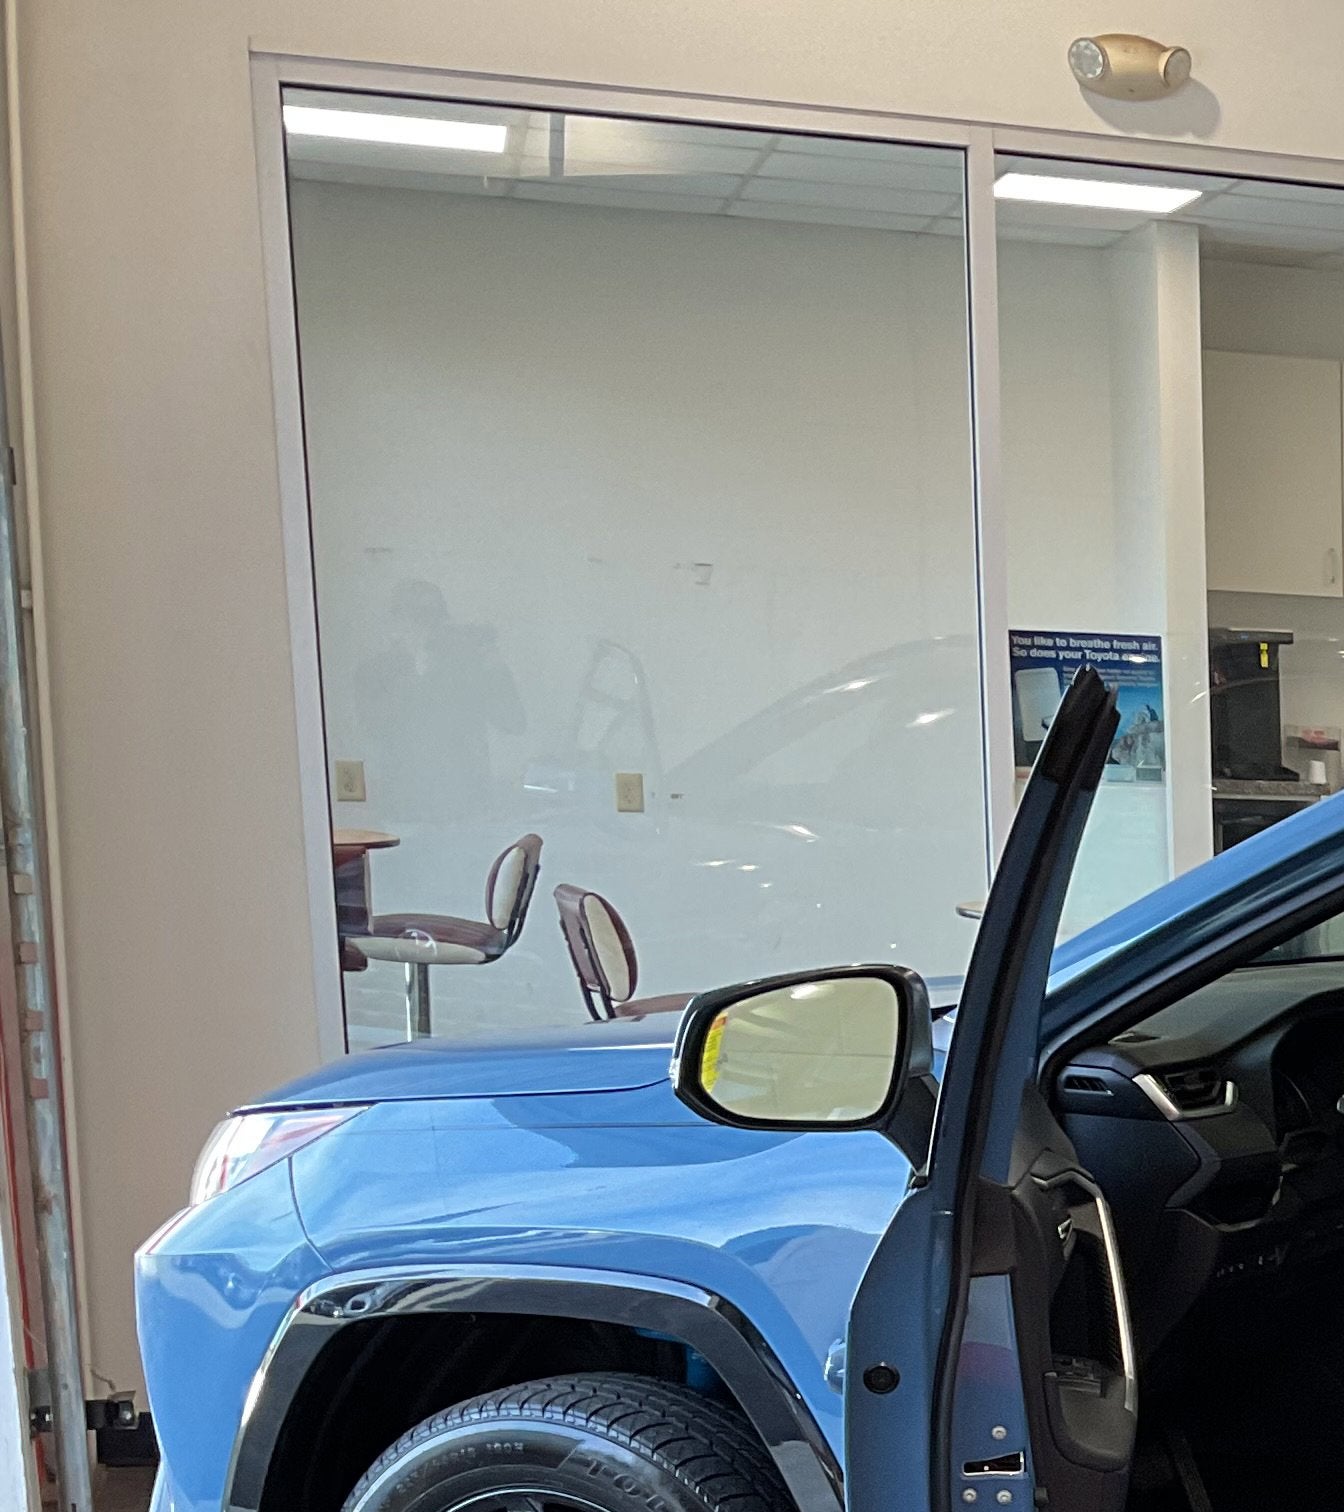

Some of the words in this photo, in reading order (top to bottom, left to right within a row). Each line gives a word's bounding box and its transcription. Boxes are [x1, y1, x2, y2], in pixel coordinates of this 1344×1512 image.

[1012, 635, 1032, 646] You
[1034, 636, 1054, 647] like
[1056, 638, 1067, 647] to
[1069, 638, 1110, 650] breathe
[1112, 640, 1140, 651] fresh
[1012, 647, 1028, 657] So
[1029, 648, 1057, 659] does
[1058, 650, 1083, 661] your
[1085, 649, 1120, 663] Toyota
